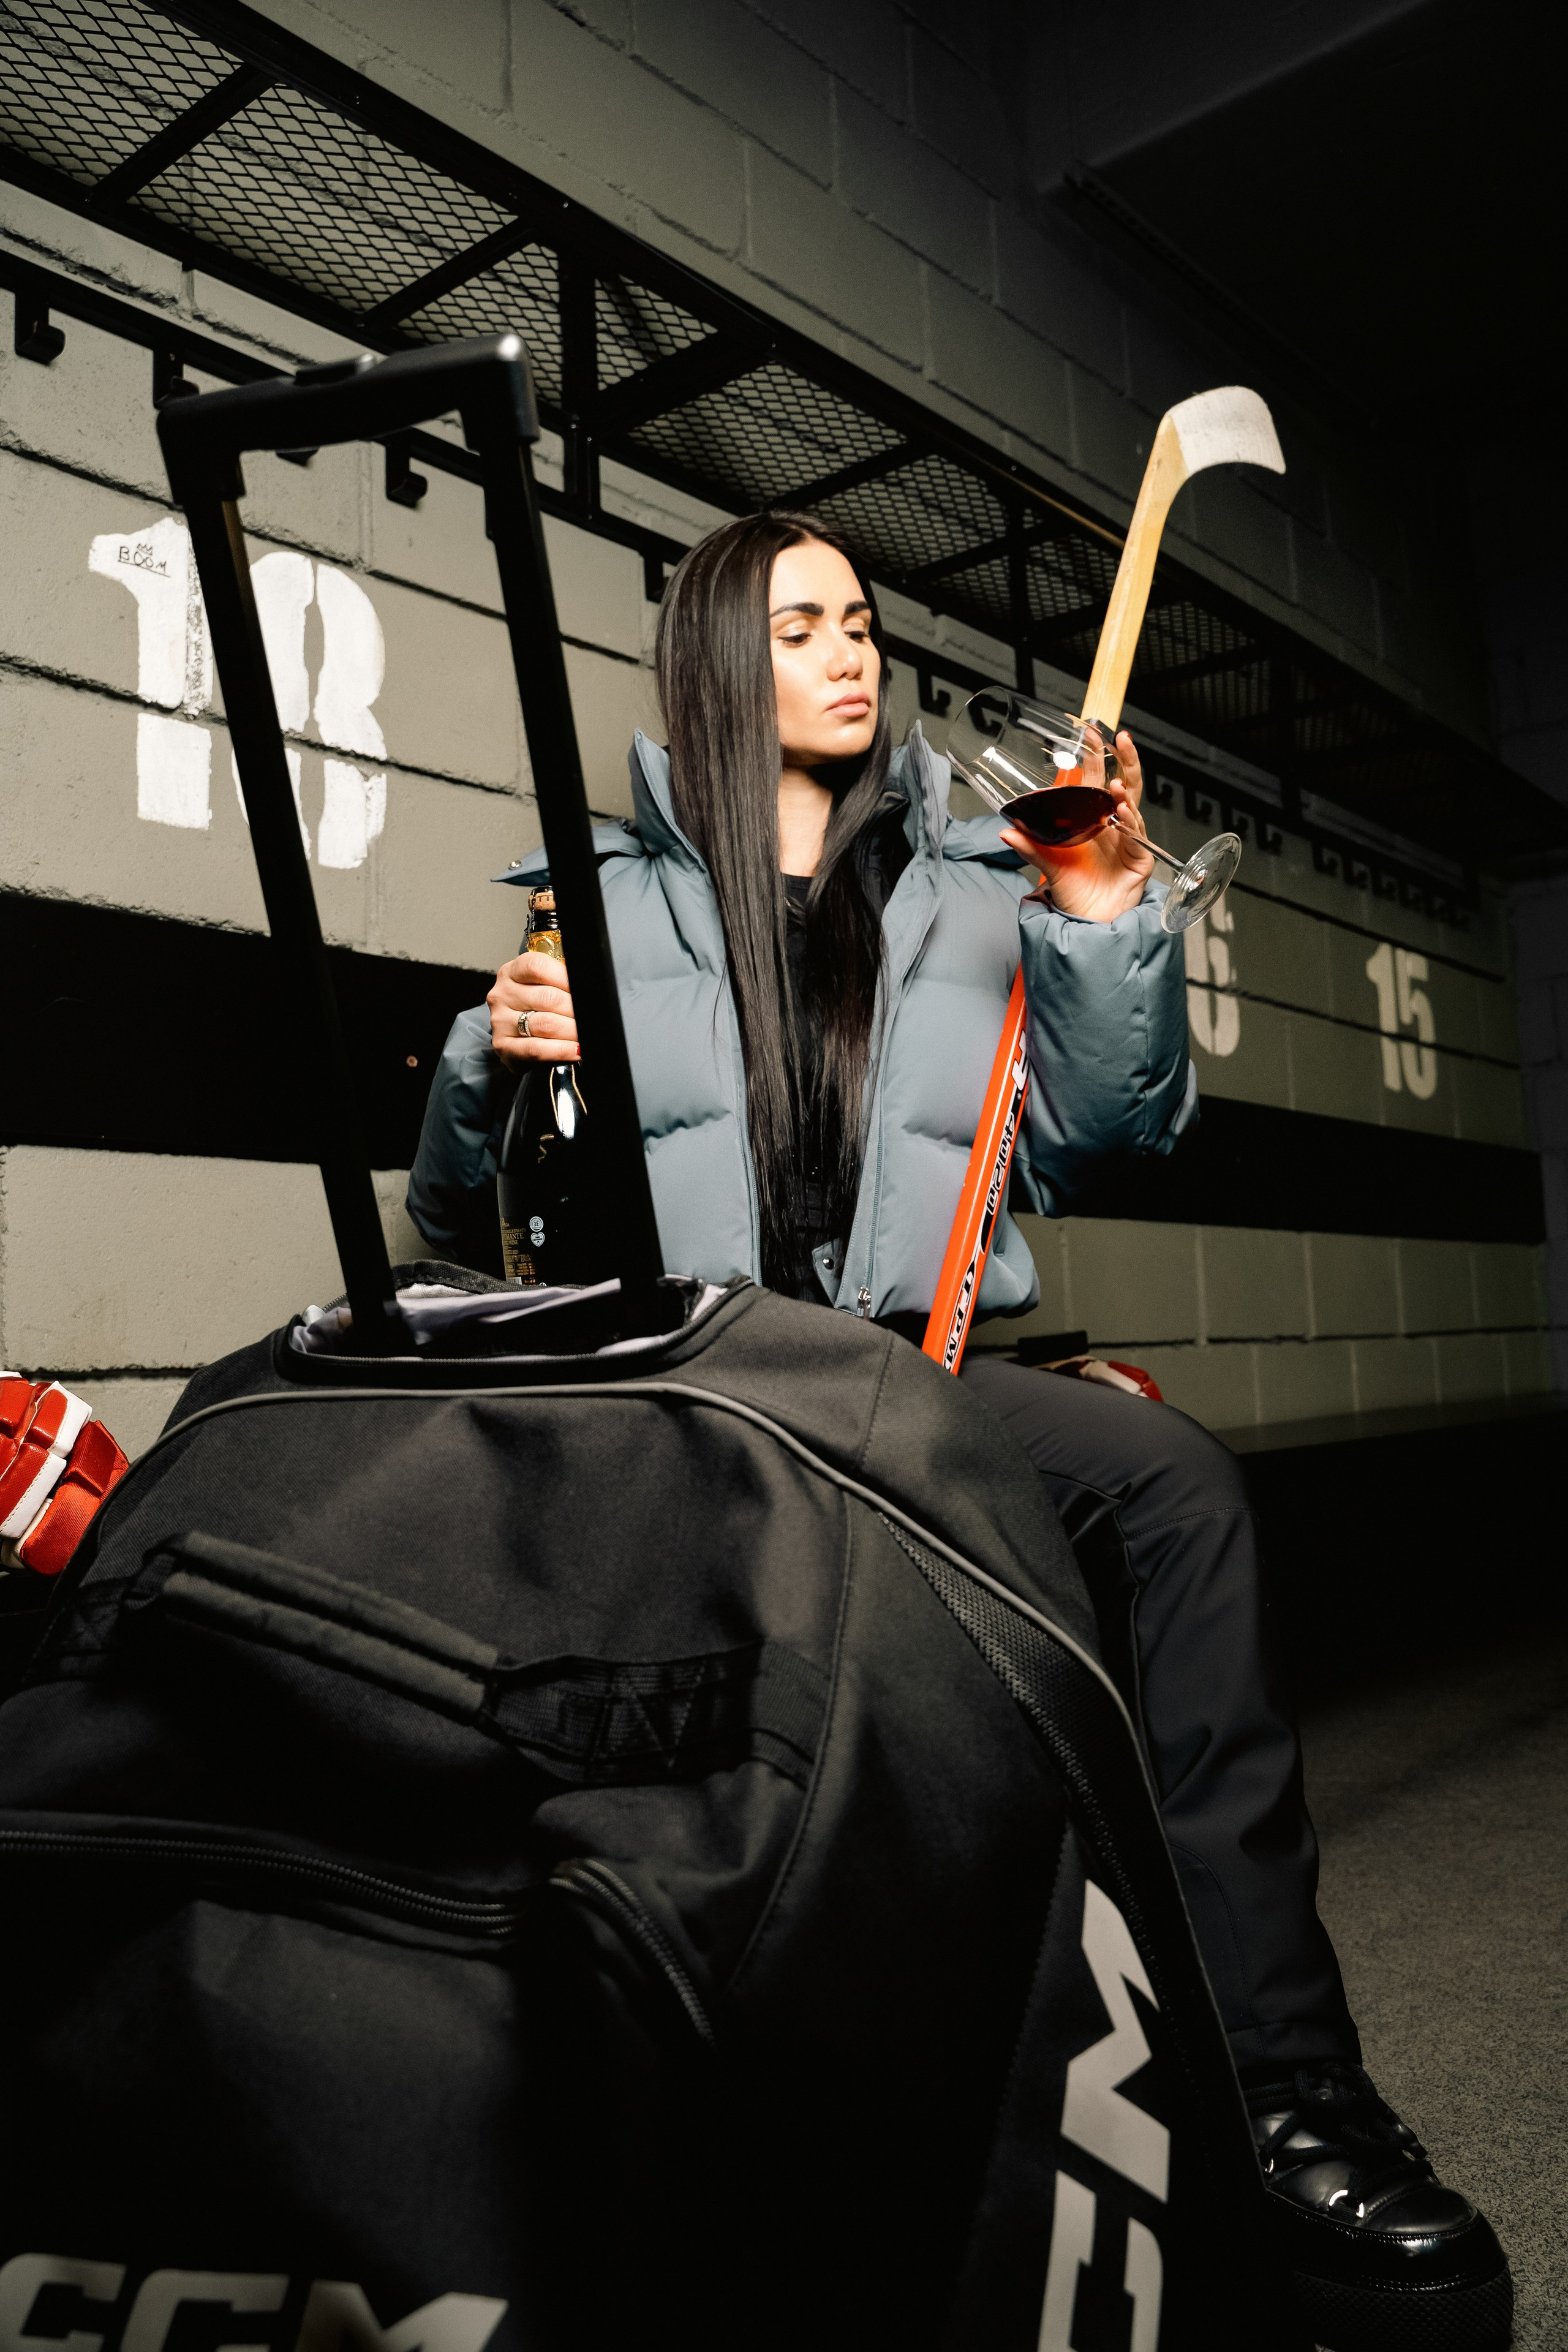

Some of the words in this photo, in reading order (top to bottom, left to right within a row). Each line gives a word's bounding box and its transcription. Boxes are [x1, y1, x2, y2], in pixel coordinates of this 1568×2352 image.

[119, 546, 167, 573] BOOM
[1365, 942, 1438, 1099] 15
[986, 1111, 1016, 1215] 4020
[947, 1278, 974, 1363] TPM
